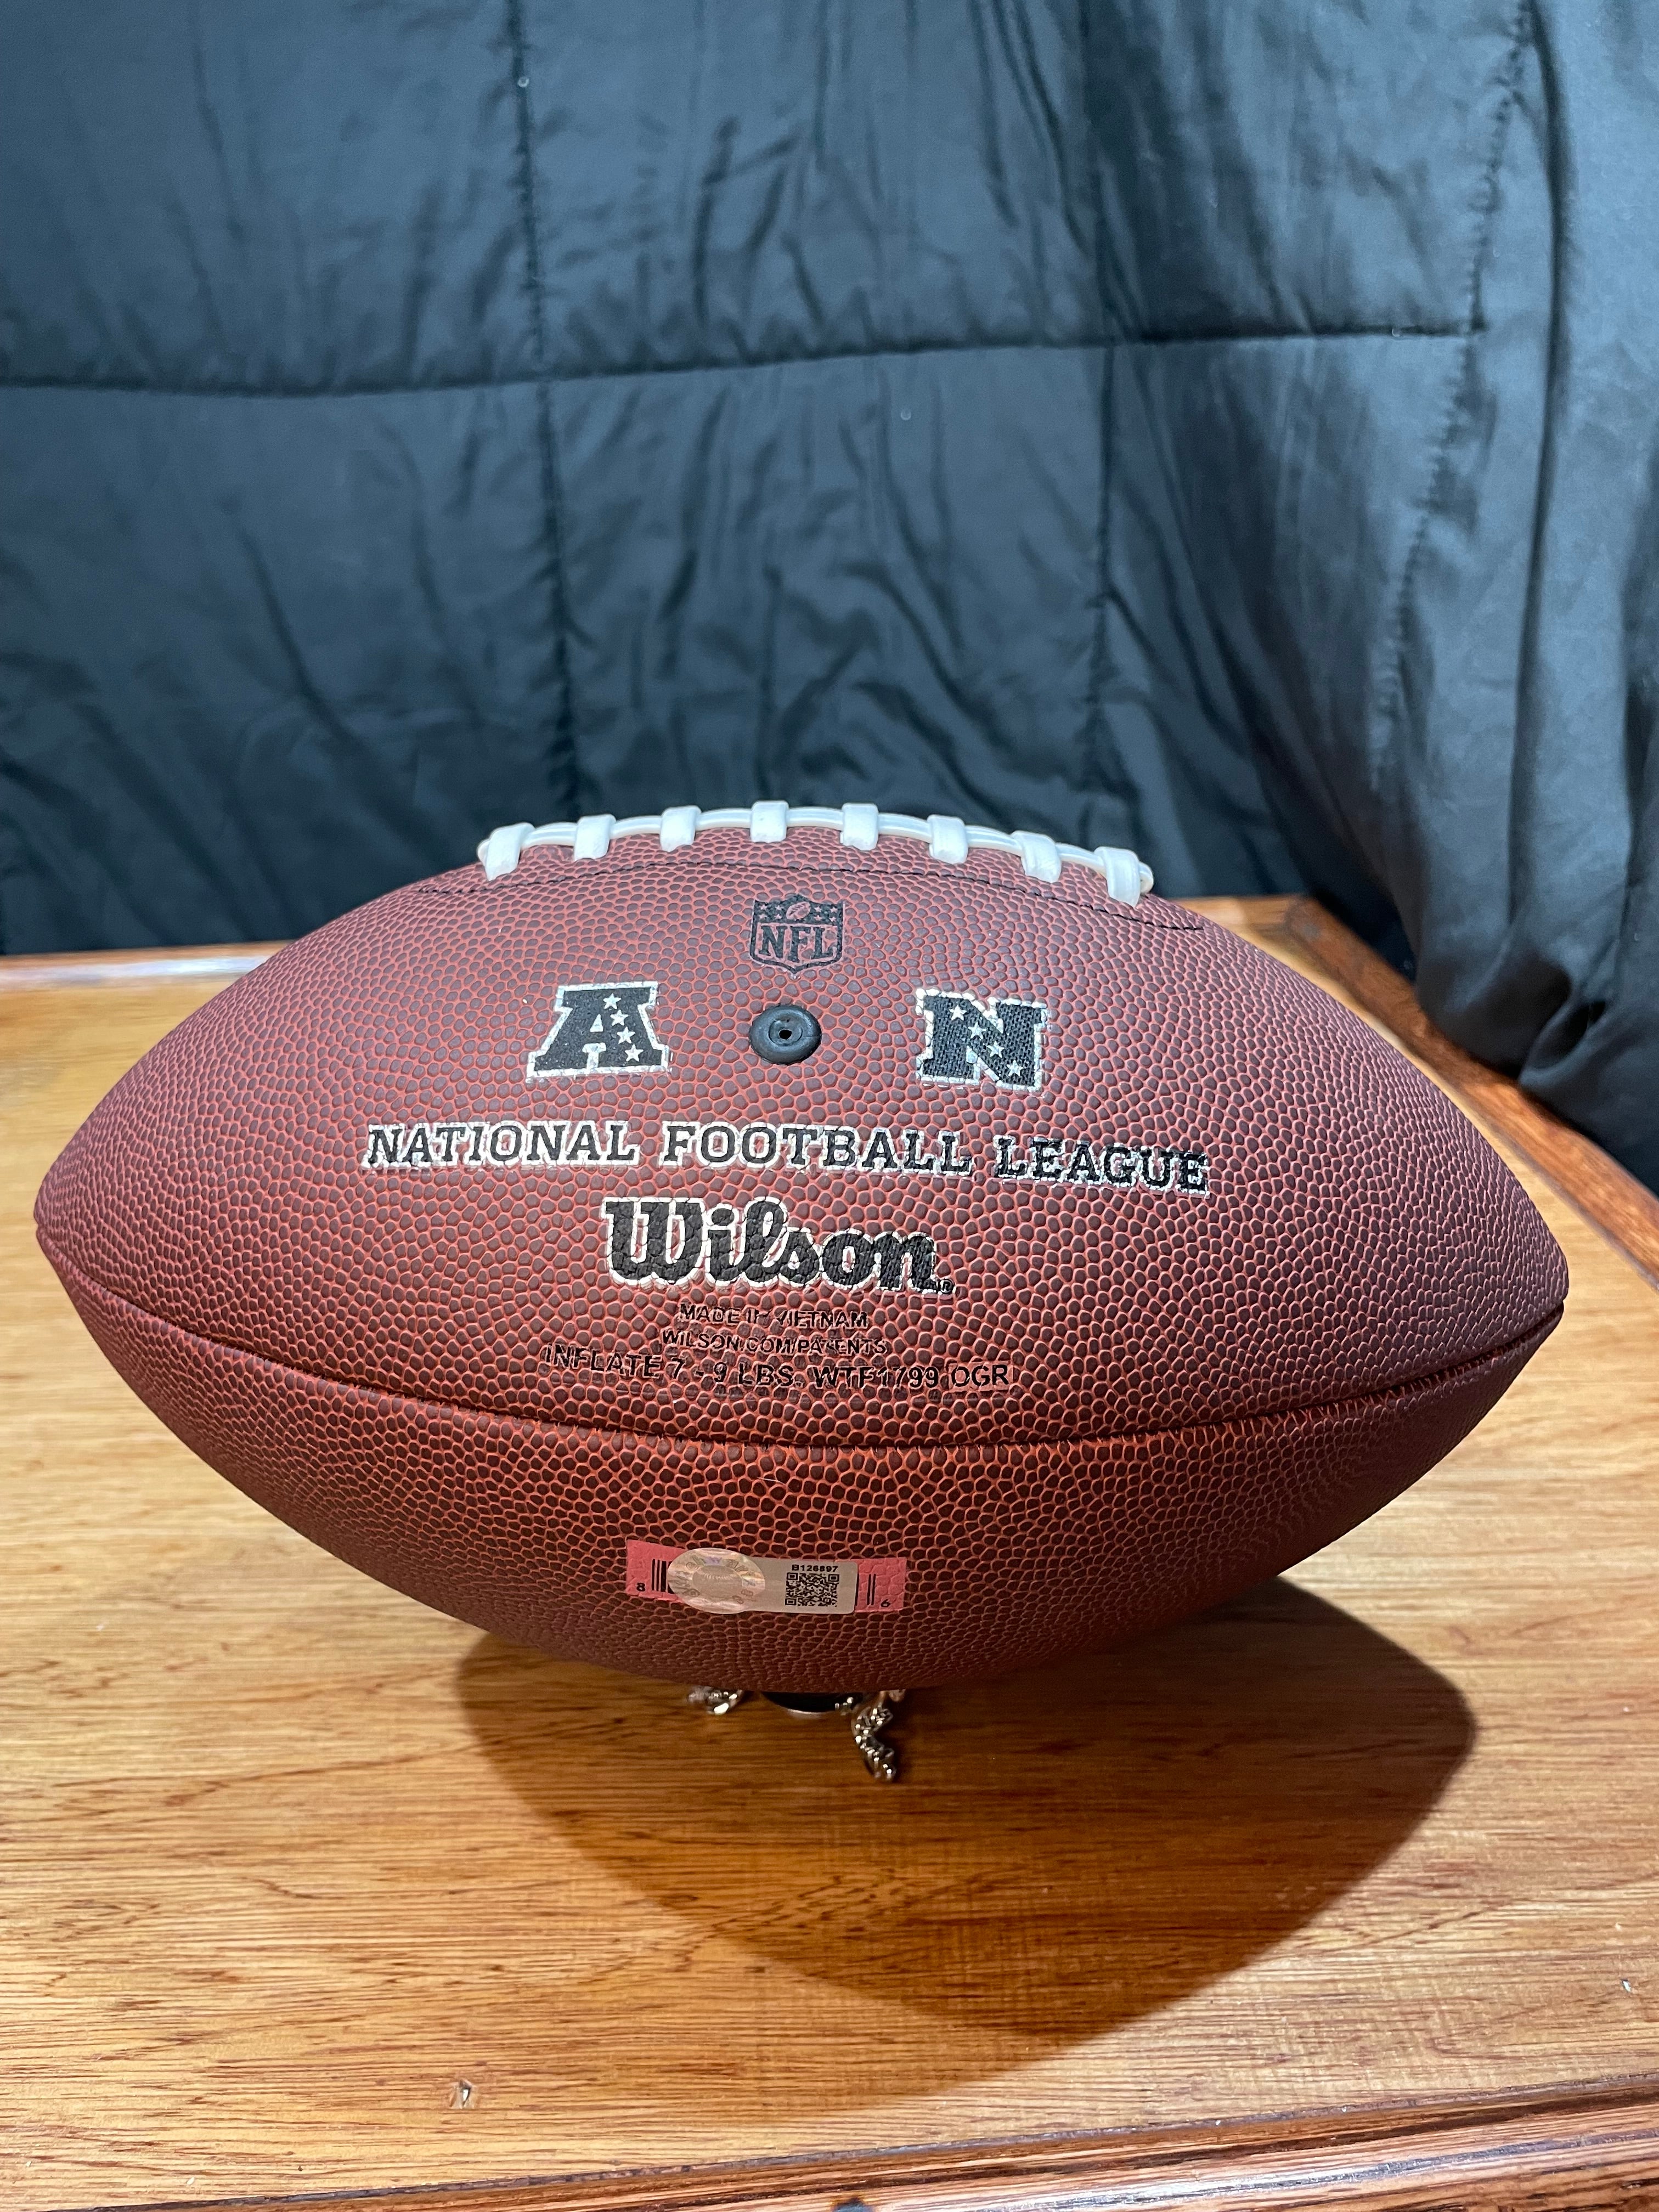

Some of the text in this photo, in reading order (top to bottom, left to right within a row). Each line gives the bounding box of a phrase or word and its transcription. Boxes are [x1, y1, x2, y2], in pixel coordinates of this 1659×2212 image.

[758, 924, 835, 964] NFL
[527, 982, 670, 1079] A
[916, 988, 1047, 1092] N
[360, 1120, 1210, 1196] NATIONAL FOOTBALL LEAGUE
[680, 1304, 741, 1324] MADE
[776, 1310, 867, 1328] VIETNAM
[545, 1344, 664, 1378] INFLATE
[671, 1358, 685, 1379] 7
[714, 1362, 727, 1383] 9
[636, 1582, 646, 1592] 8
[880, 1598, 891, 1608] 6
